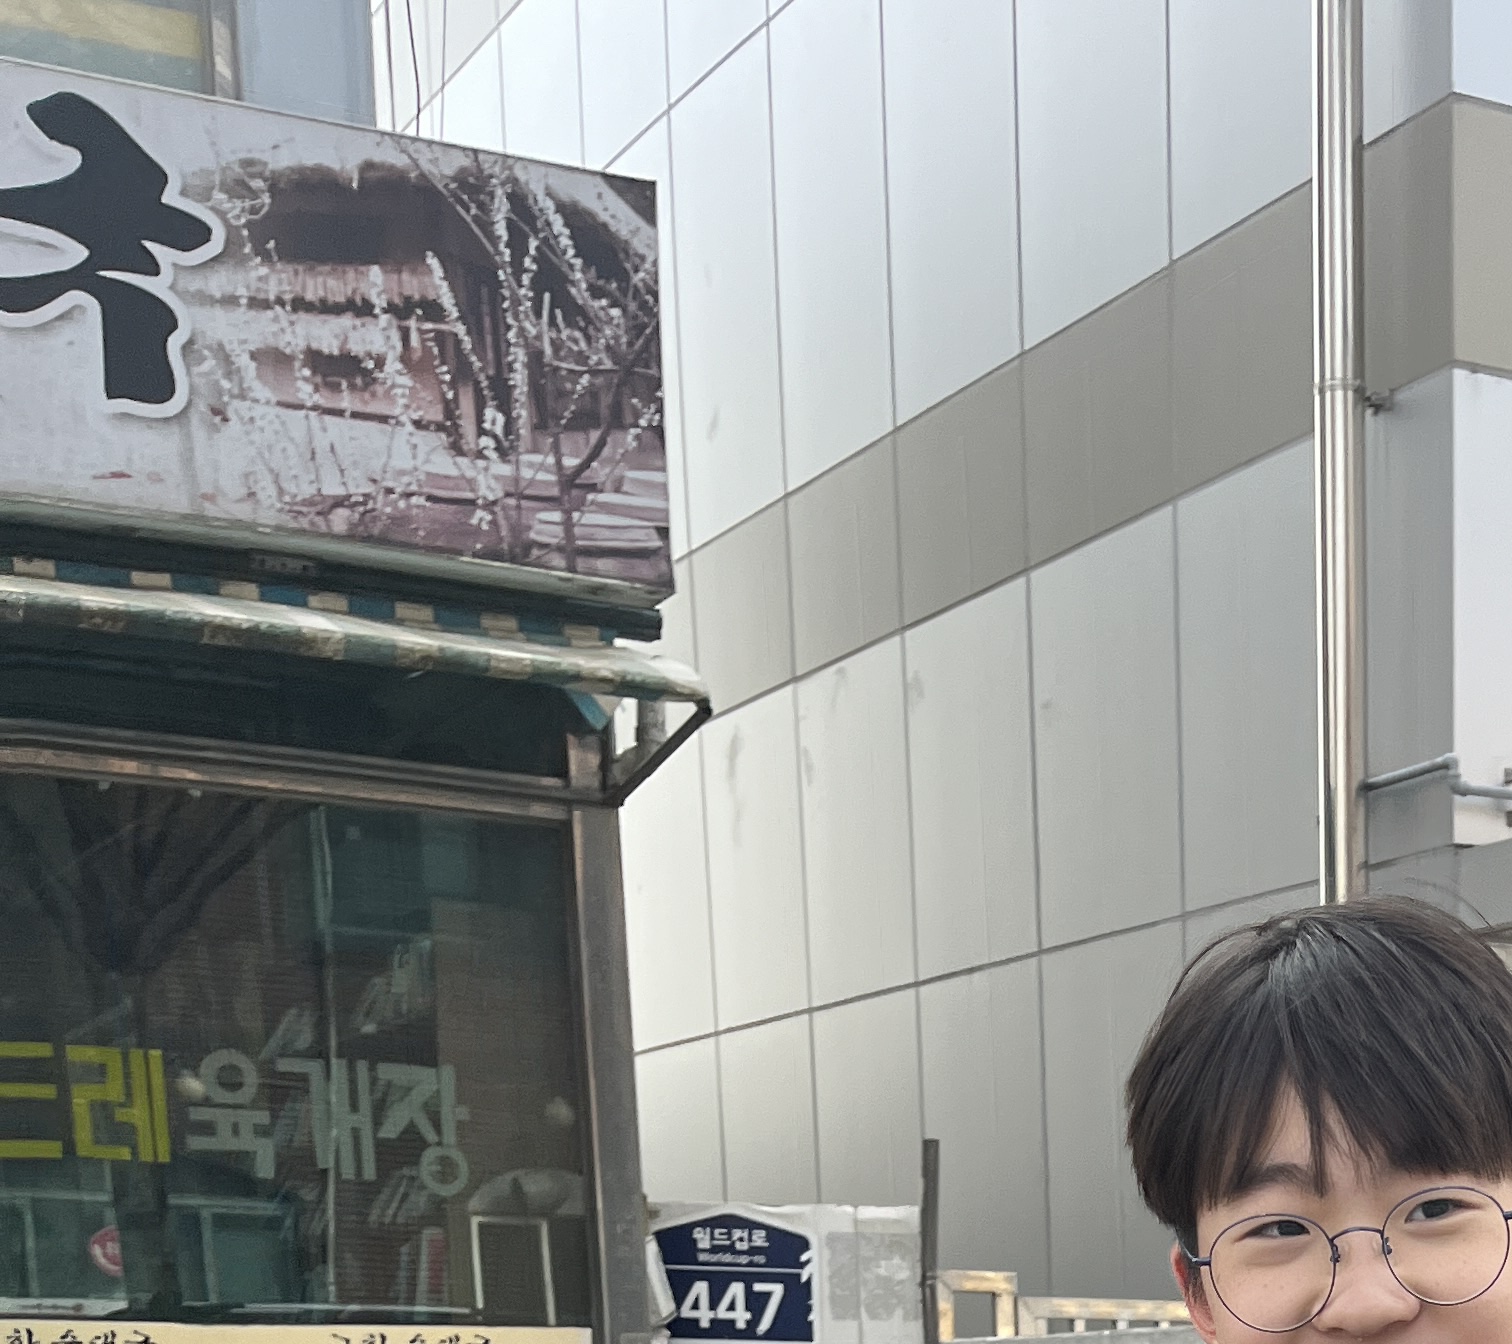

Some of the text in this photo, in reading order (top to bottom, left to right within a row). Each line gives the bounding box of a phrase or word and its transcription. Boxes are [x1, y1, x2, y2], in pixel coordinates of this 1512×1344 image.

[187, 1048, 469, 1196] 육개장
[692, 1226, 769, 1251] 월드컵로
[679, 1279, 785, 1336] 447
